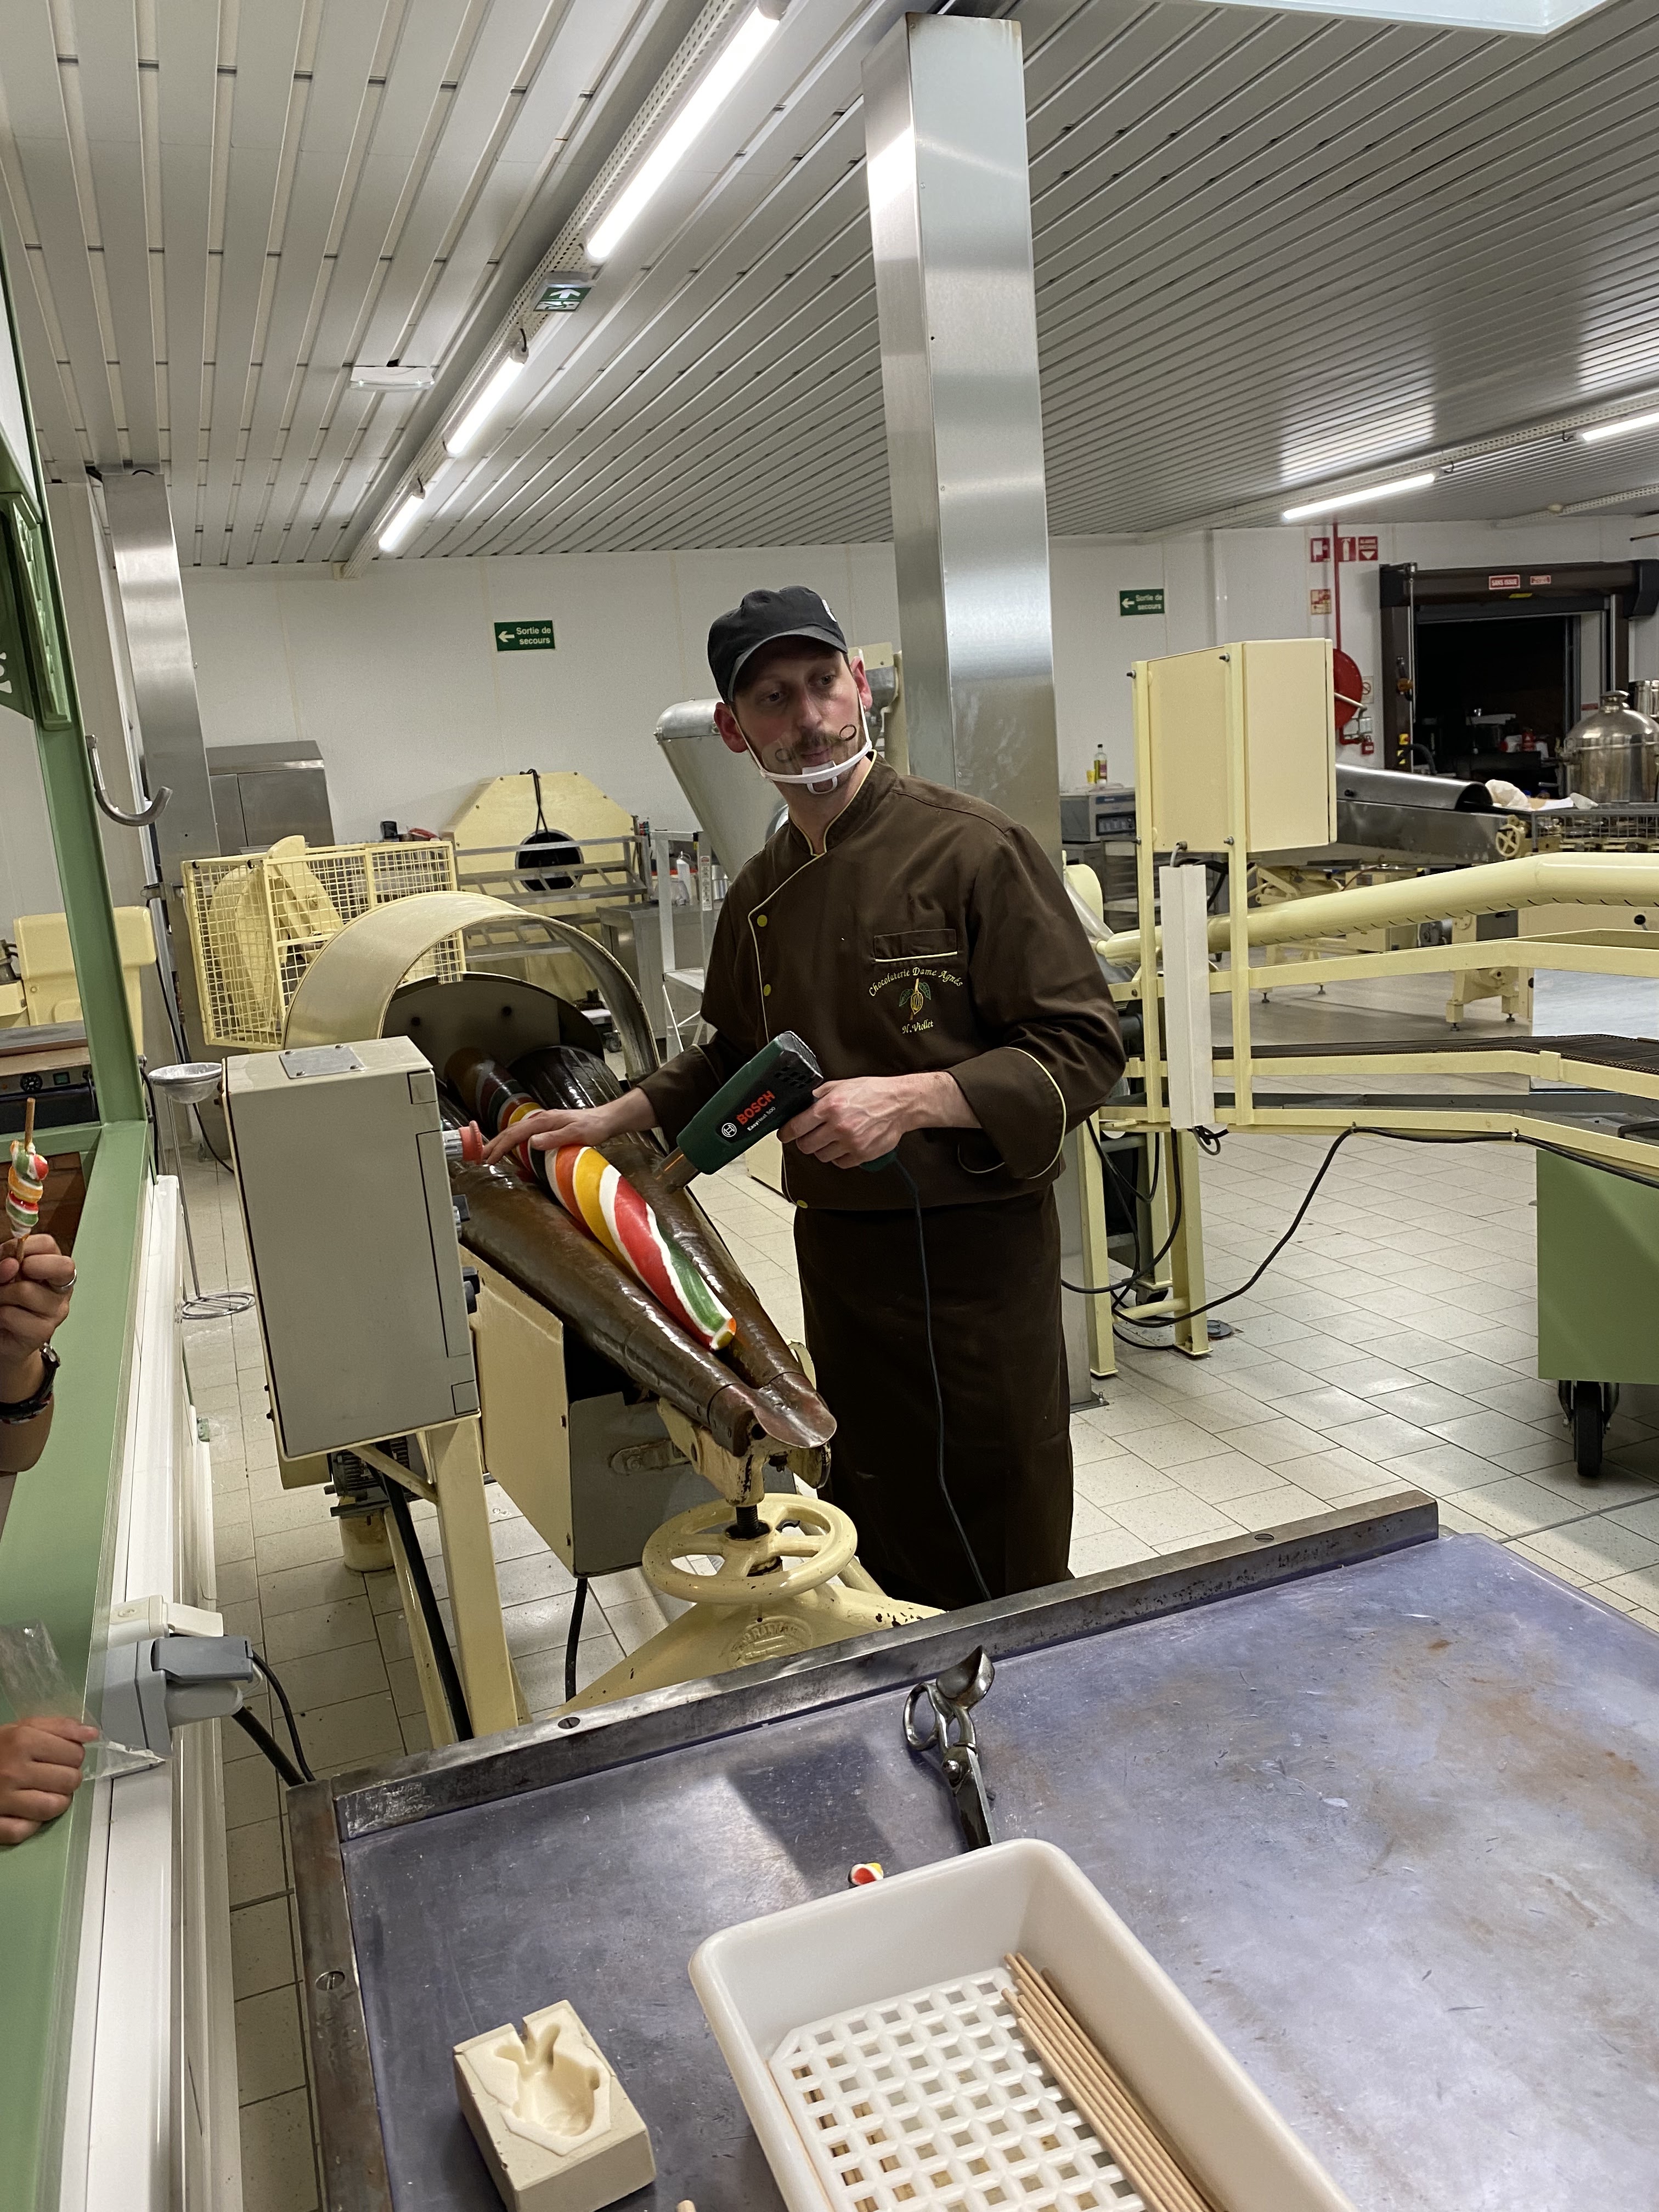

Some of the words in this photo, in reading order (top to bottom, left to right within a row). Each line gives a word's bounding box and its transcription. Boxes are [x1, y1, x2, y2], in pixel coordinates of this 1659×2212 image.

[869, 969, 910, 996] Chocolaterie
[912, 967, 937, 976] Dame
[736, 1090, 775, 1125] BOSCH
